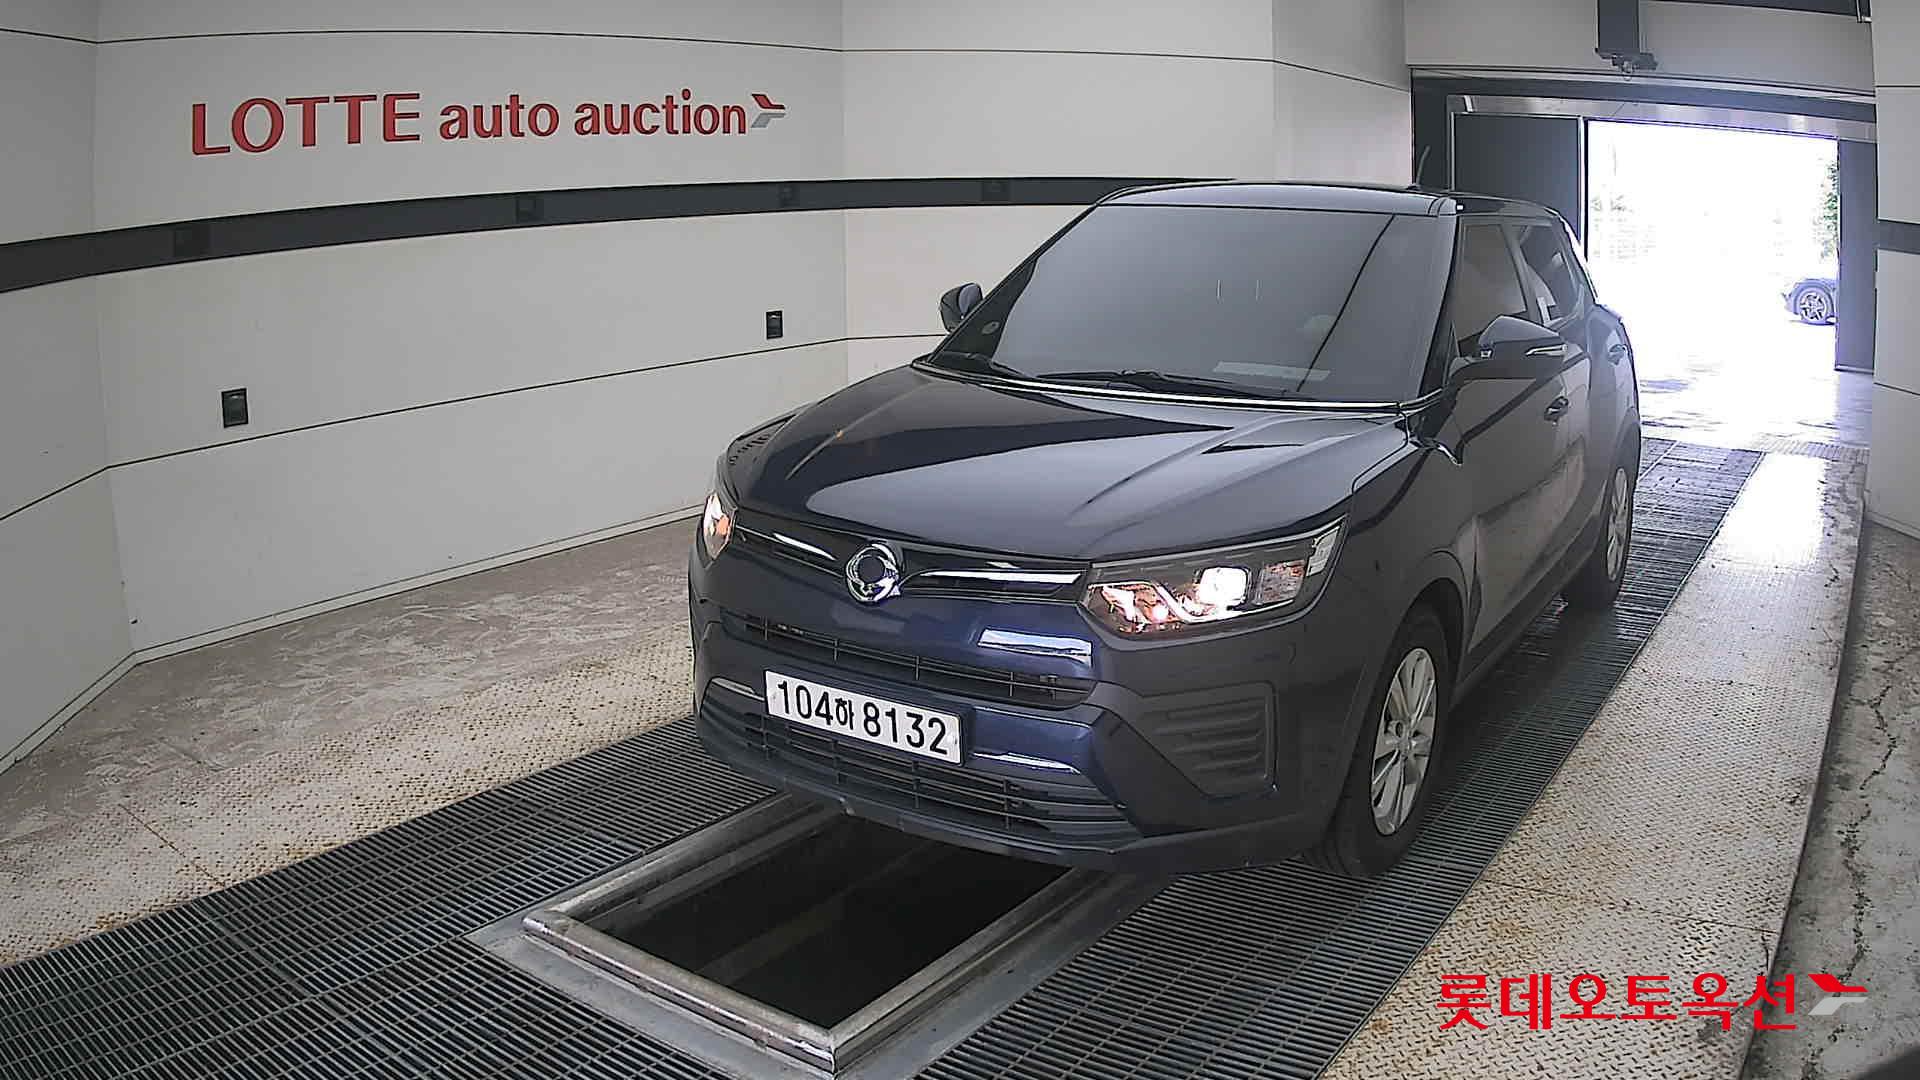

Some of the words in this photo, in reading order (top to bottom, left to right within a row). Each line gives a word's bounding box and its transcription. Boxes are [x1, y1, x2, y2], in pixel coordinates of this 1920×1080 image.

[192, 92, 420, 156] LOTTE
[438, 94, 560, 140] auto
[574, 88, 747, 136] auction
